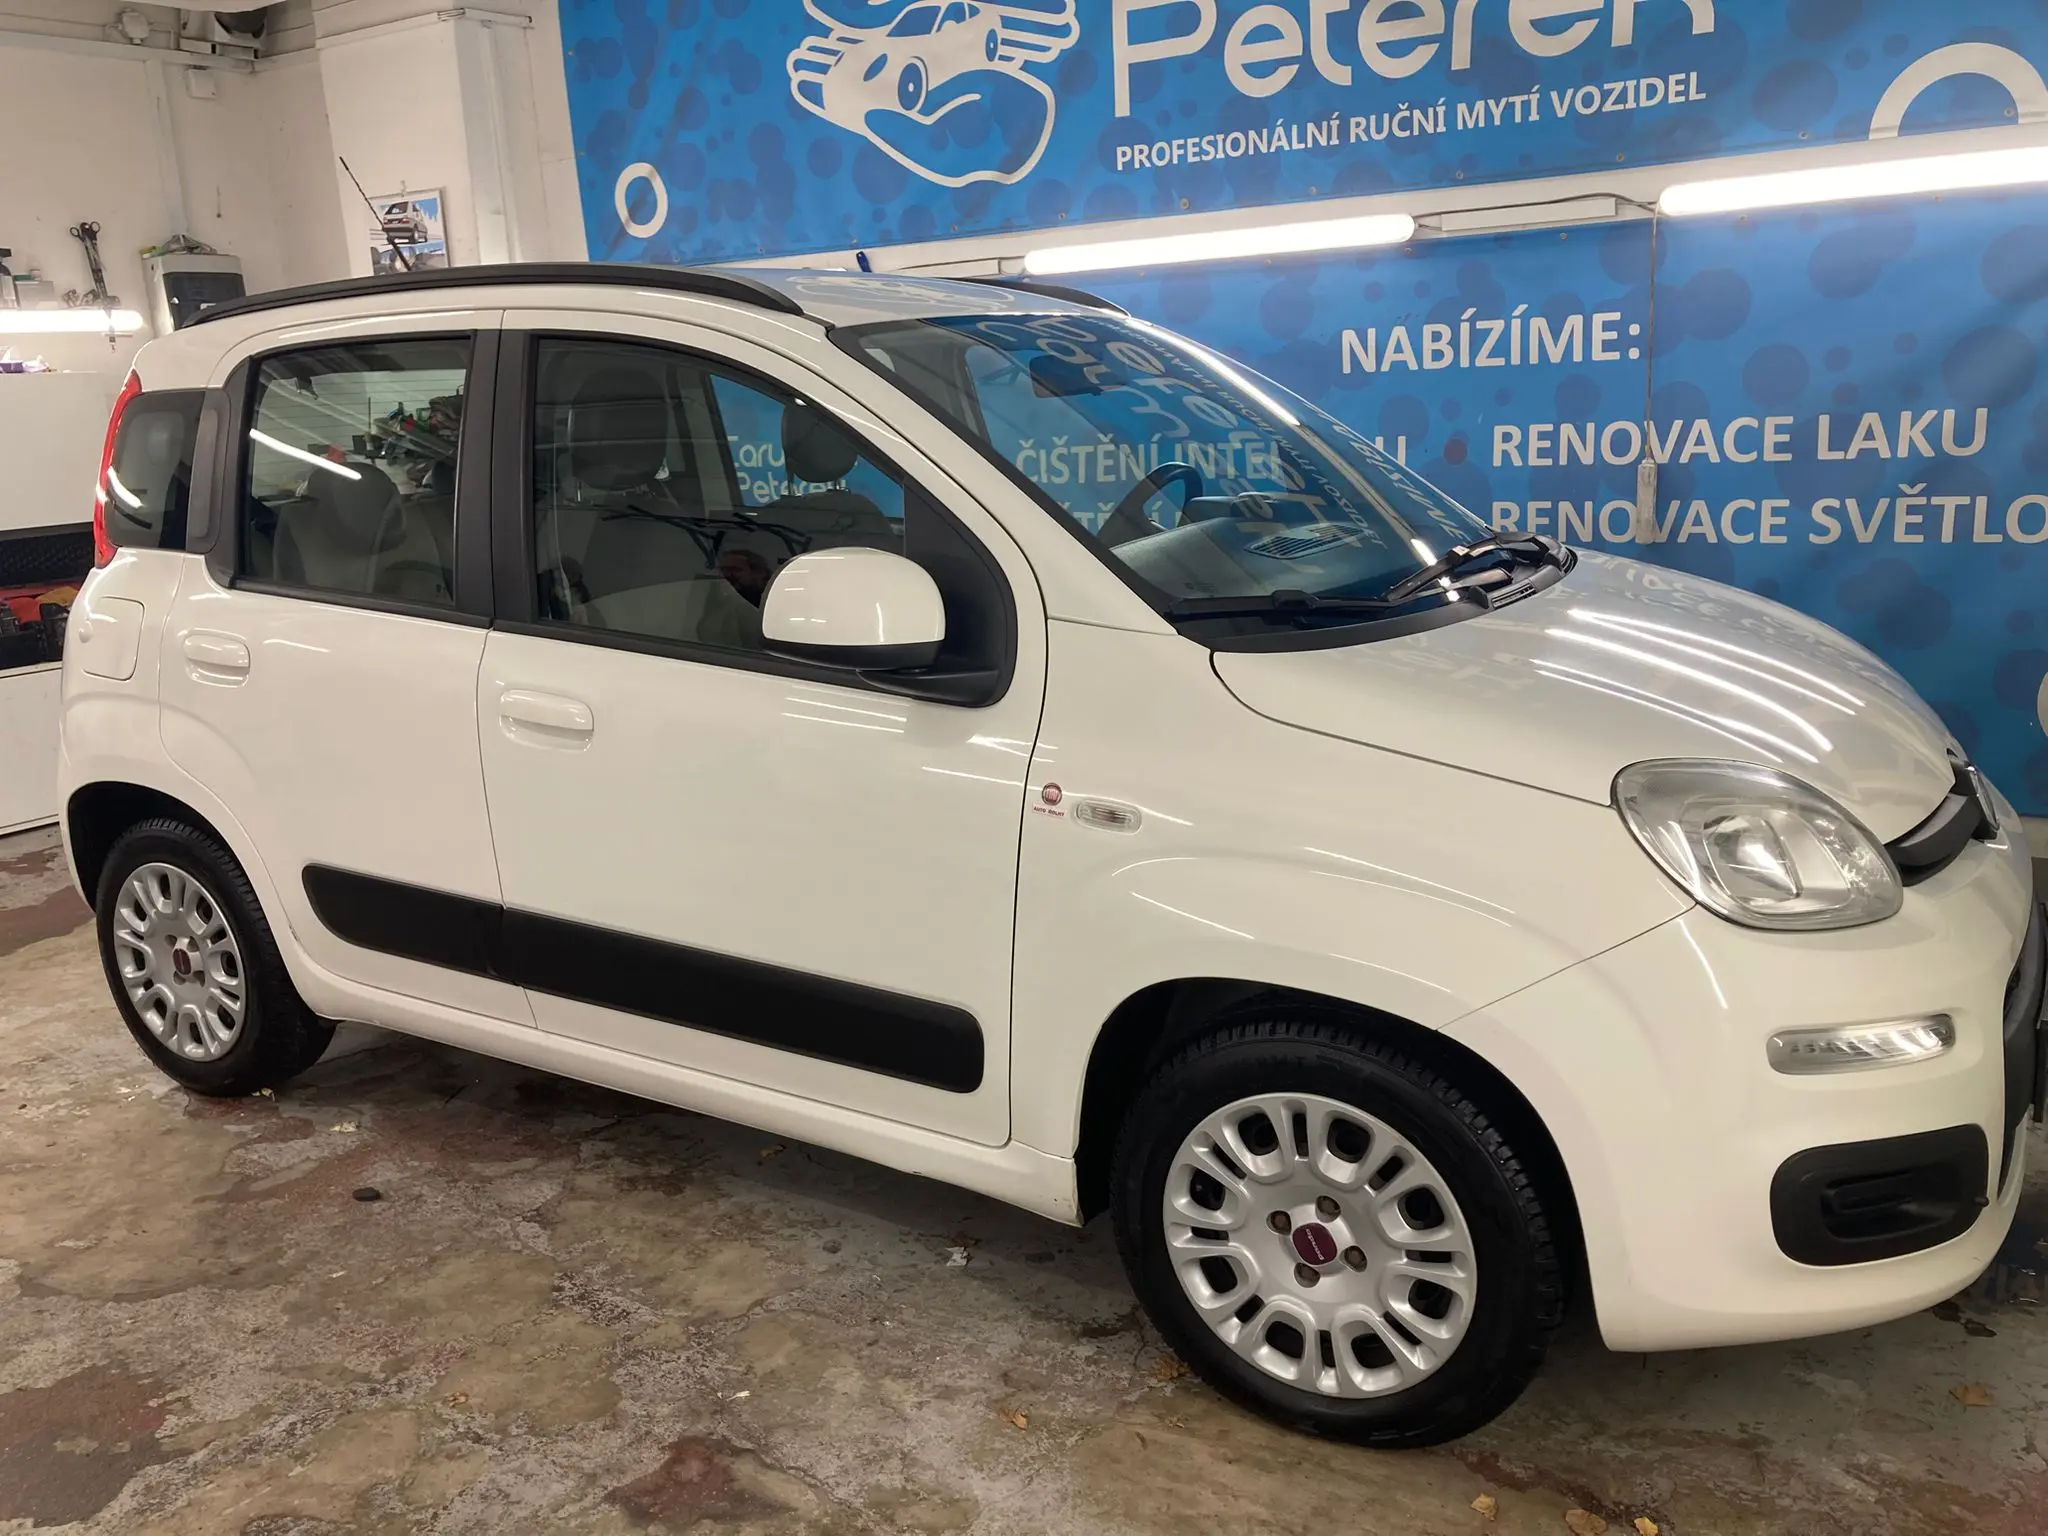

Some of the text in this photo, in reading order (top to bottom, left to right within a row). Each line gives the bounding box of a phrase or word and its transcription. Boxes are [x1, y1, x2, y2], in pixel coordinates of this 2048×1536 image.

[1115, 71, 1707, 171] PROFESIONÁLNÍ RUČNÍ MYTÍ VOZIDEL
[1341, 304, 1641, 374] NABÍZÍME:
[1015, 433, 1162, 484] ČIŠTĚNÍ
[1492, 407, 1989, 468] RENOVACE LAKU
[1491, 498, 1791, 544] RENOVACE
